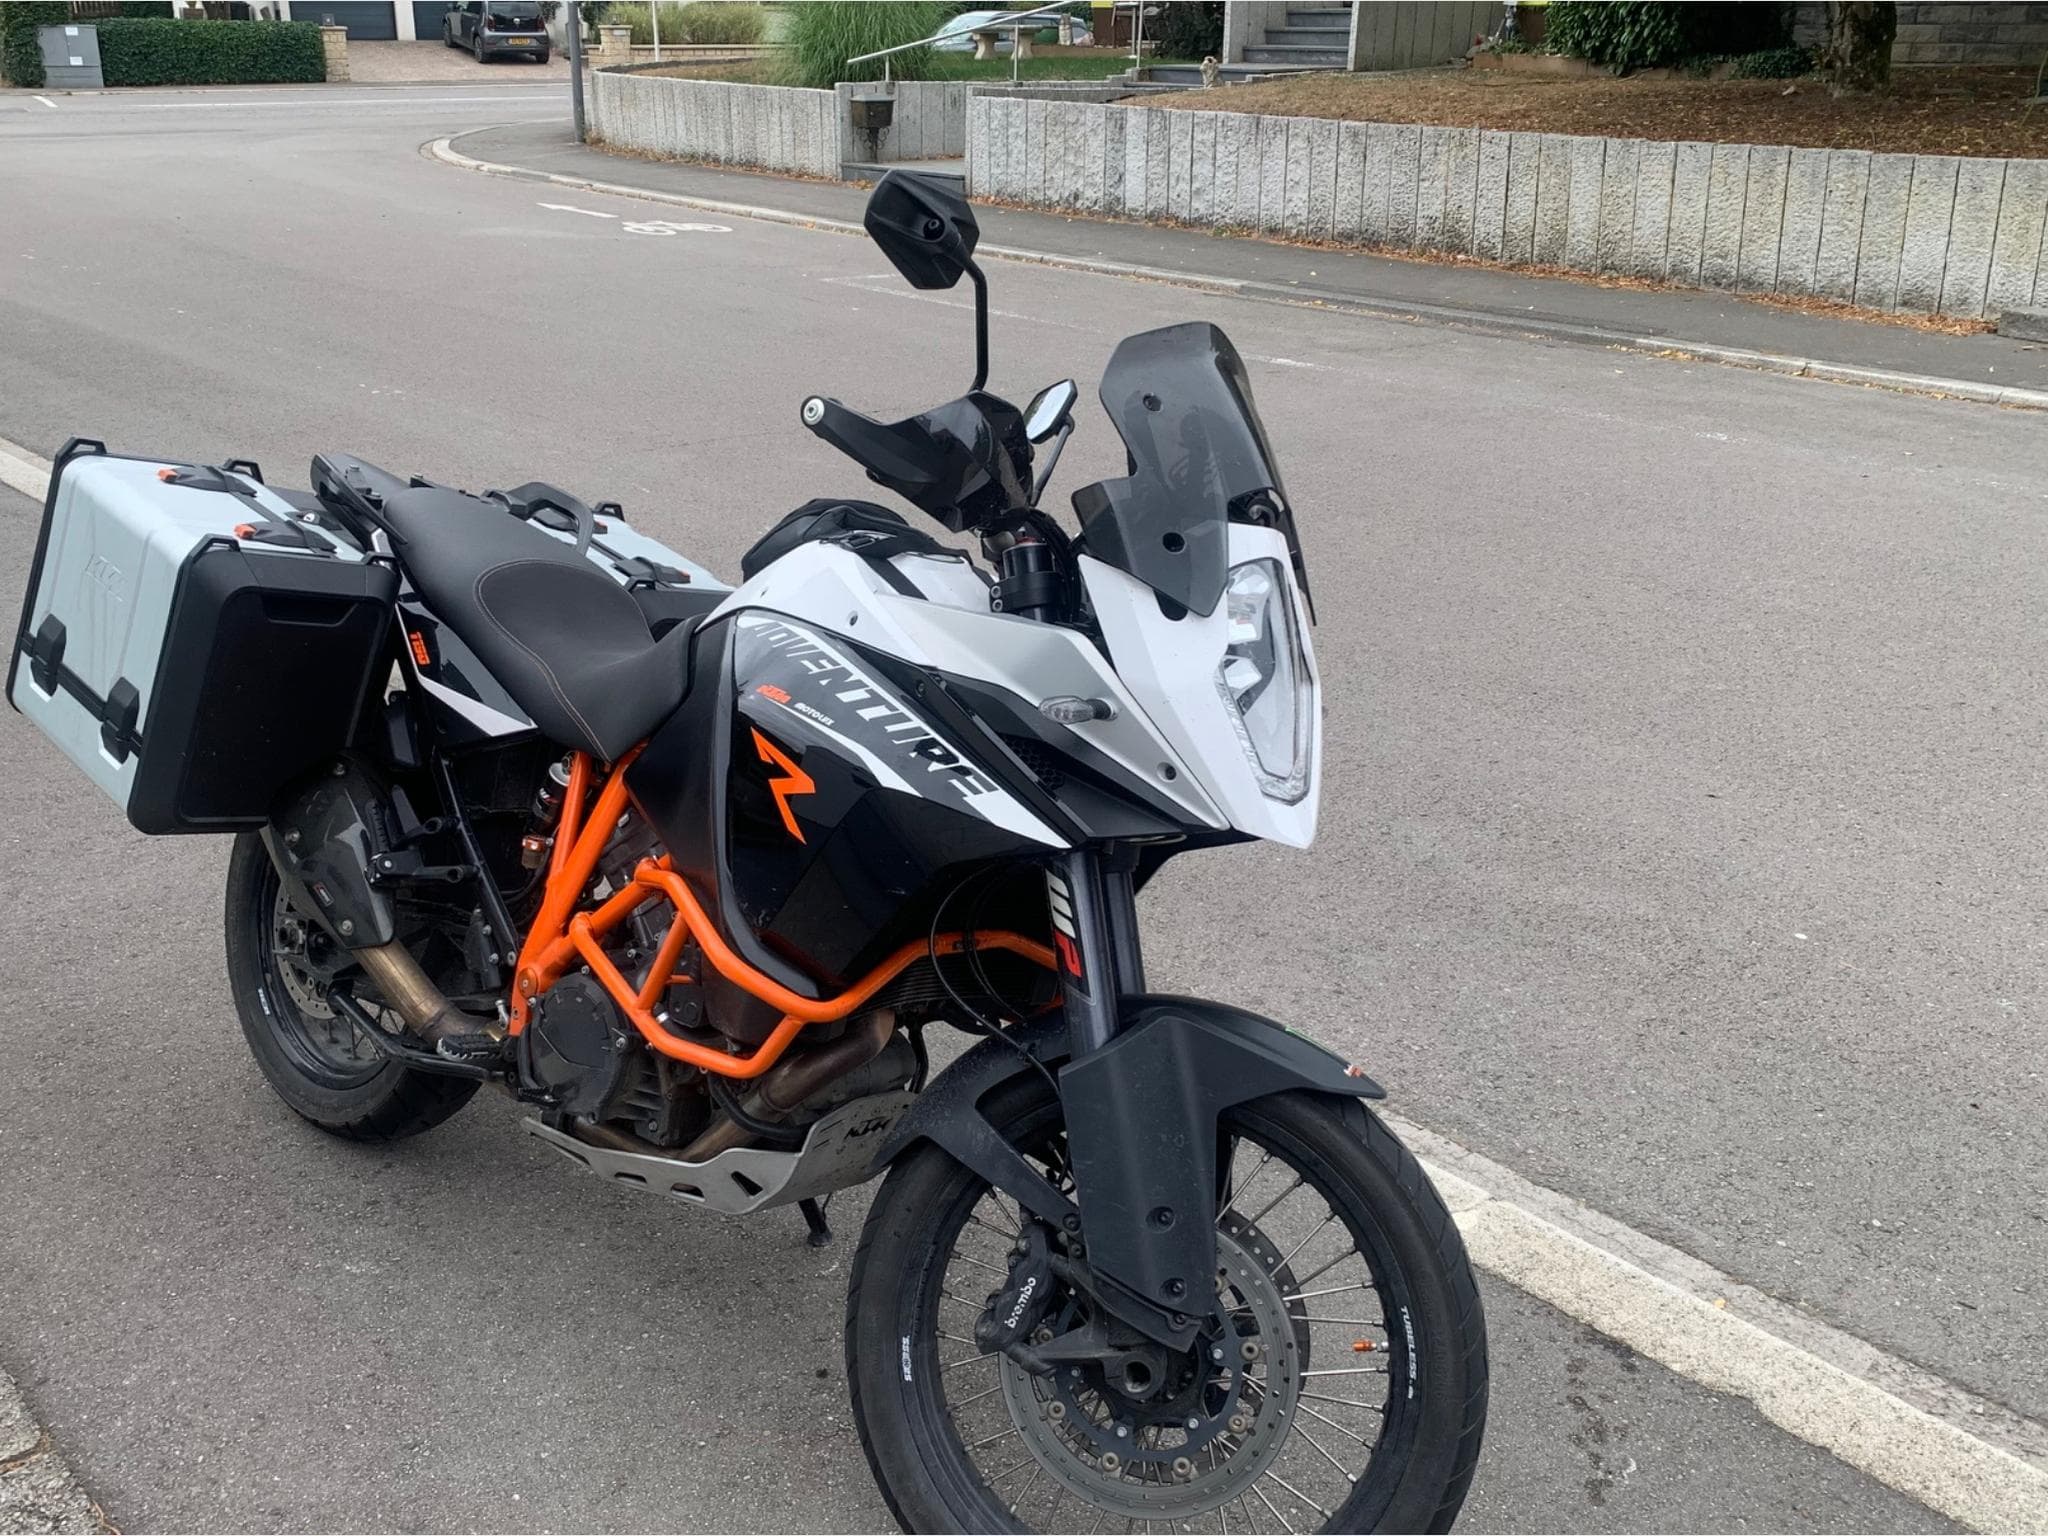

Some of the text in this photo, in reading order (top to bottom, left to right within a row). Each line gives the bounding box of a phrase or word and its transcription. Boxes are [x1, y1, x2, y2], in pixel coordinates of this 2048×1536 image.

[756, 684, 792, 704] KTM
[1004, 1277, 1036, 1329] brembo
[1400, 1305, 1417, 1380] TUBELESS
